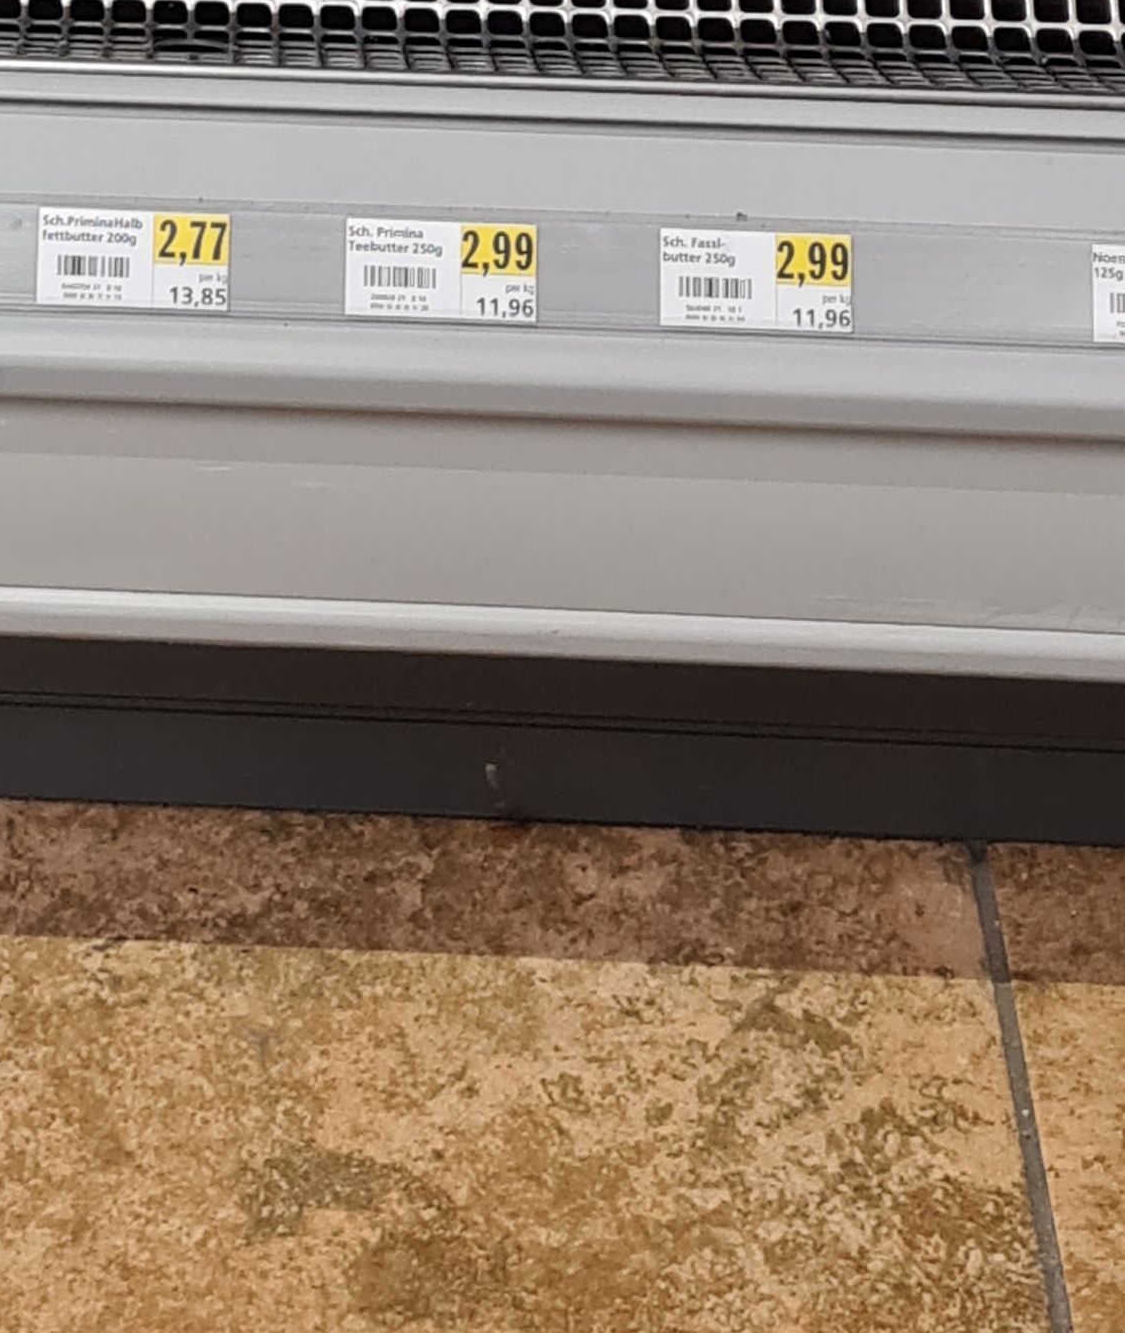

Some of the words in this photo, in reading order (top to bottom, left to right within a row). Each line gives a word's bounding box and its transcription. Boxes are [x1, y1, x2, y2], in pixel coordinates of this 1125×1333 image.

[42, 230, 104, 243] fettbutter
[107, 232, 137, 247] 200g
[349, 225, 373, 238] Sch.
[377, 227, 424, 240] Primina
[159, 220, 228, 266] 2,77
[349, 241, 409, 254] Teebutter
[412, 243, 443, 257] 250g
[662, 236, 687, 248] Sch.
[691, 238, 726, 250] Fassl-
[461, 231, 533, 276] 2,99
[662, 251, 702, 264] butter
[705, 253, 735, 267] 250g
[776, 241, 848, 287] 2,99
[1095, 267, 1123, 281] 125g
[169, 287, 227, 306] 13,85
[476, 298, 534, 318] 11,96
[793, 309, 851, 330] 11,96
